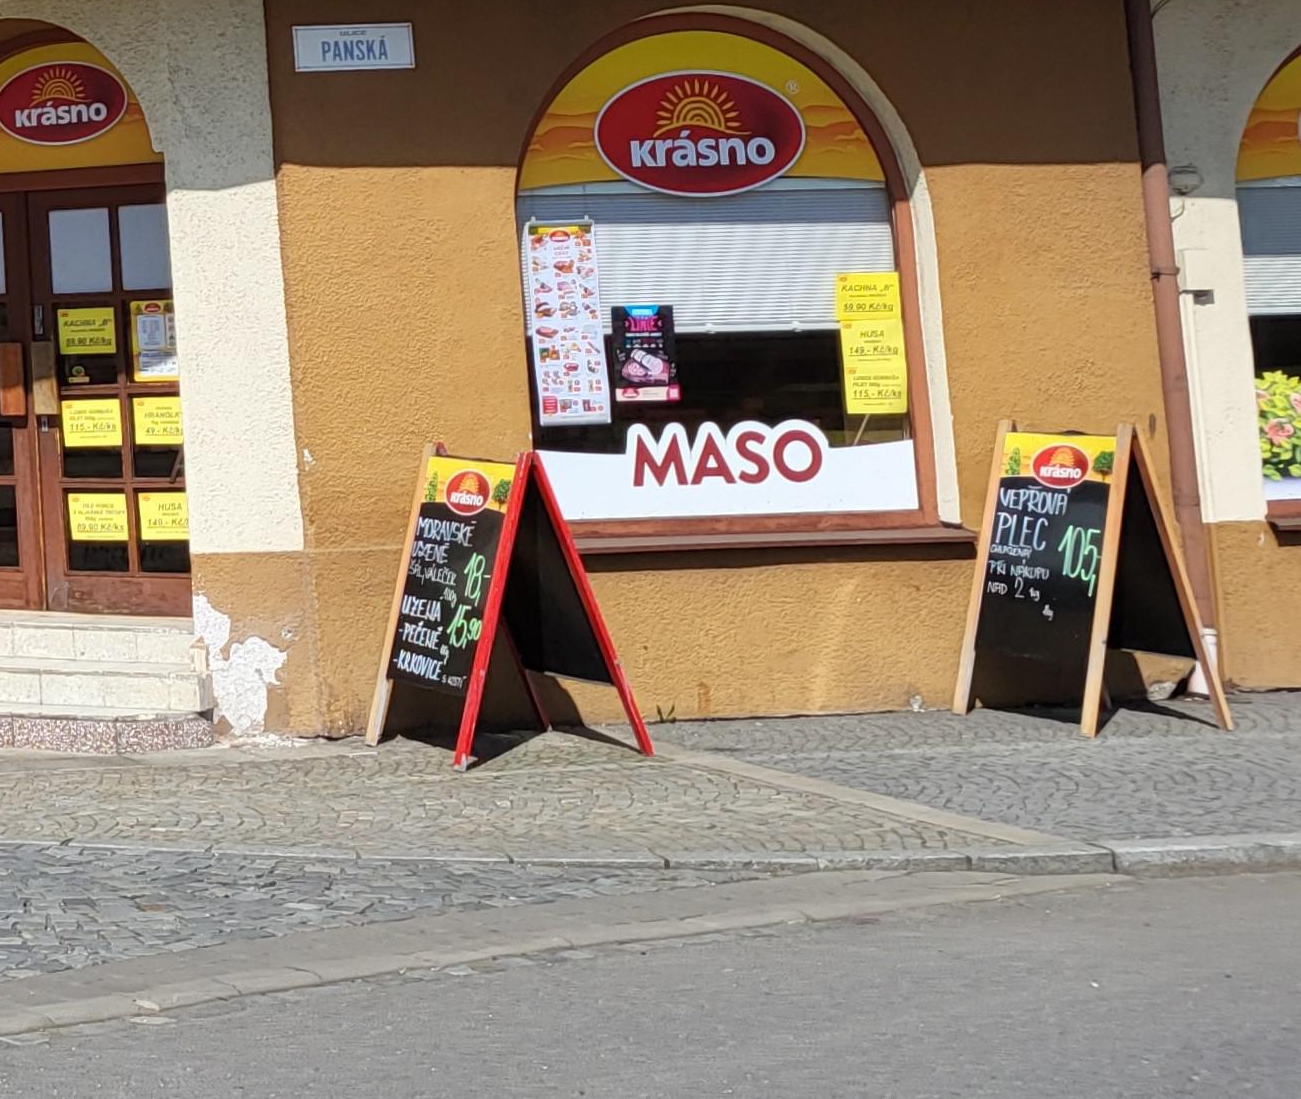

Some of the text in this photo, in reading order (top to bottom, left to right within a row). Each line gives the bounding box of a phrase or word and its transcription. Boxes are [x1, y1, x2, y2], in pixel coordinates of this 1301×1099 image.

[321, 35, 388, 62] PANSKÁ
[14, 100, 108, 128] Krásno
[629, 130, 776, 168] Krásno
[860, 329, 885, 339] HUSA
[633, 430, 823, 488] MASO
[1039, 464, 1083, 479] Krásno
[158, 503, 182, 511] HUSA
[450, 490, 484, 507] Krásno
[1000, 485, 1072, 517] VEPŘOVÁ
[416, 516, 477, 548] MORAVSKÉ
[995, 512, 1049, 552] PLEC
[1010, 559, 1050, 581] NÁKUPU
[987, 581, 1008, 596] NAD
[1014, 577, 1025, 599] 2
